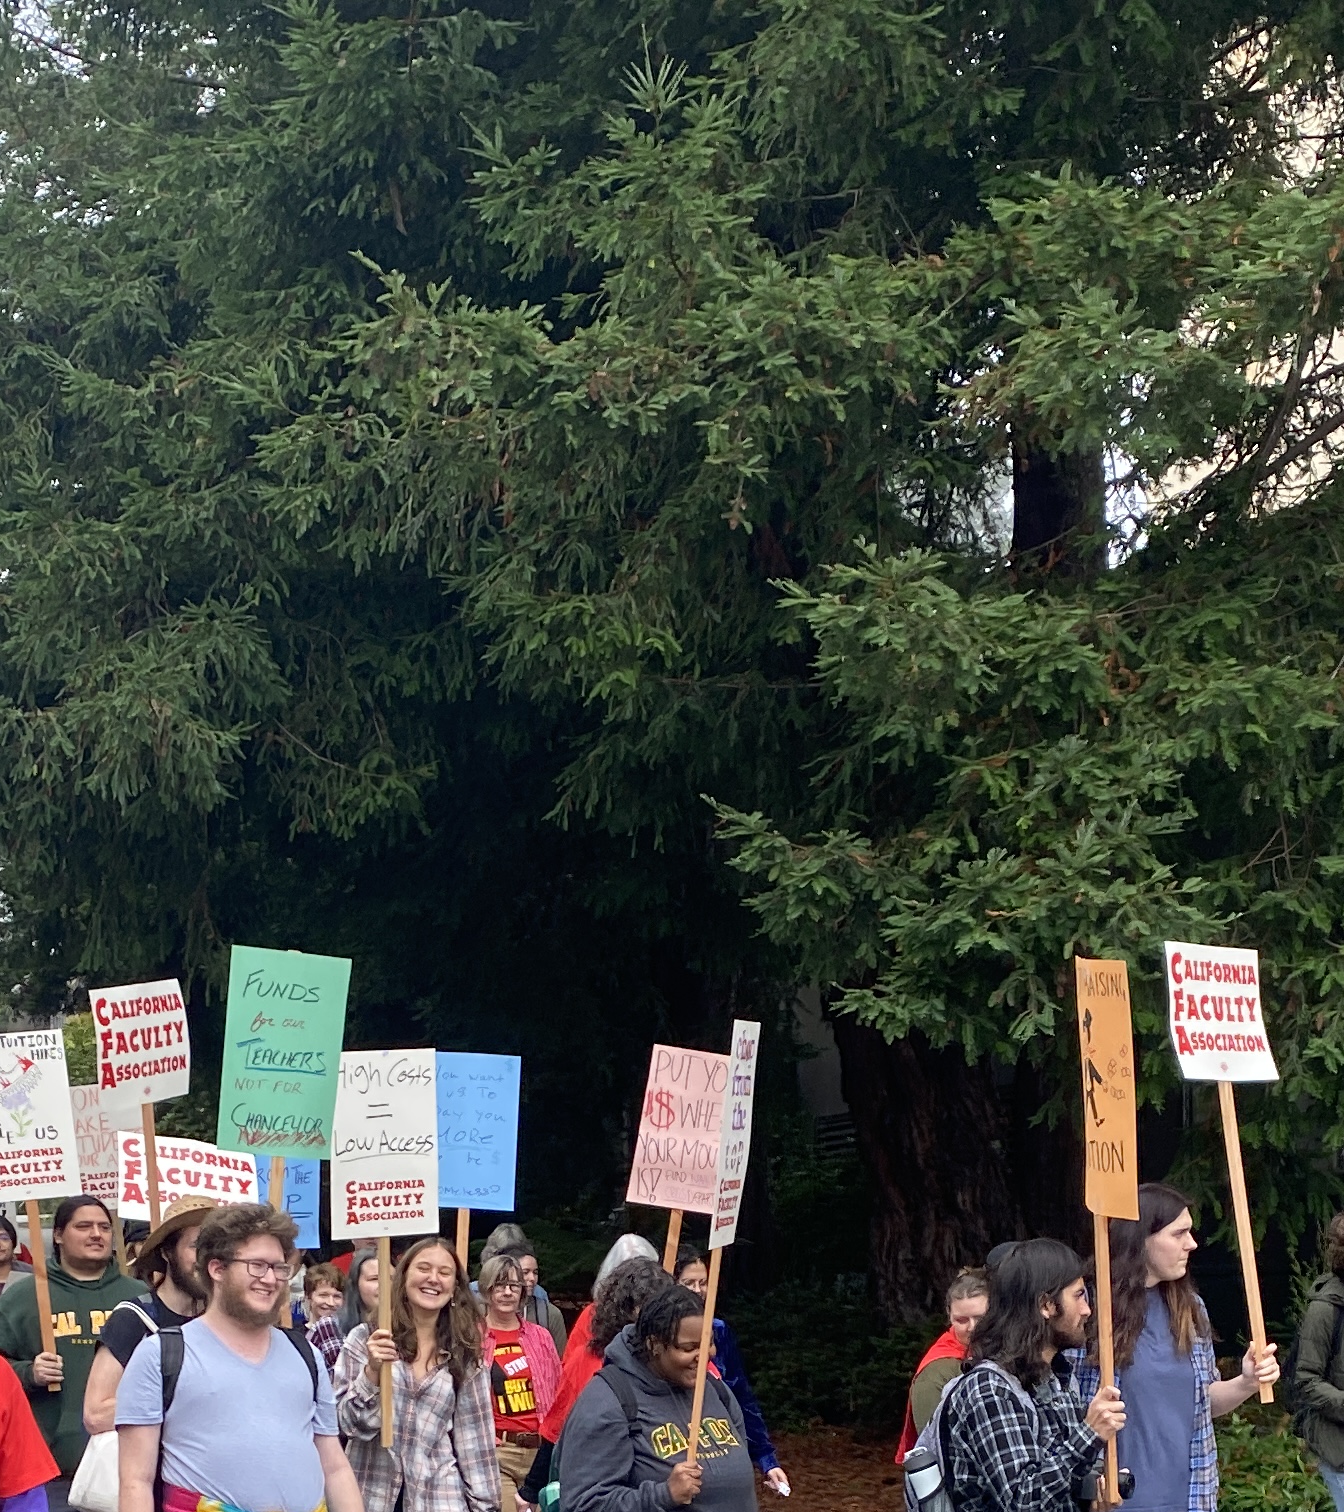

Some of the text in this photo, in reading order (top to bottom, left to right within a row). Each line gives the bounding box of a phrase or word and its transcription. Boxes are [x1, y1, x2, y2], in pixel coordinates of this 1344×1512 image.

[1171, 952, 1256, 985] CALIFORNIA
[242, 969, 320, 1002] FUNDS
[96, 993, 183, 1026] CALIFORNIA
[1174, 988, 1256, 1022] FACULTY
[101, 1020, 184, 1059] FACULTY
[236, 1037, 326, 1073] TEACHERS
[1175, 1025, 1266, 1056] ASSOCIATION
[101, 1054, 187, 1090] ASSOCIATION
[235, 1078, 304, 1095] NOT FOR
[387, 1057, 432, 1087] Costs
[655, 1050, 703, 1090] PUT
[35, 1125, 58, 1140] US
[122, 1139, 254, 1174] CLIFORNIA
[638, 1132, 677, 1167] YOUR
[81, 1182, 118, 1193] FACU
[345, 1179, 425, 1194] CALIFORNIA
[346, 1193, 424, 1210] FACULTY
[346, 1210, 424, 1225] ASSOCIATION
[504, 1378, 528, 1394] BUT
